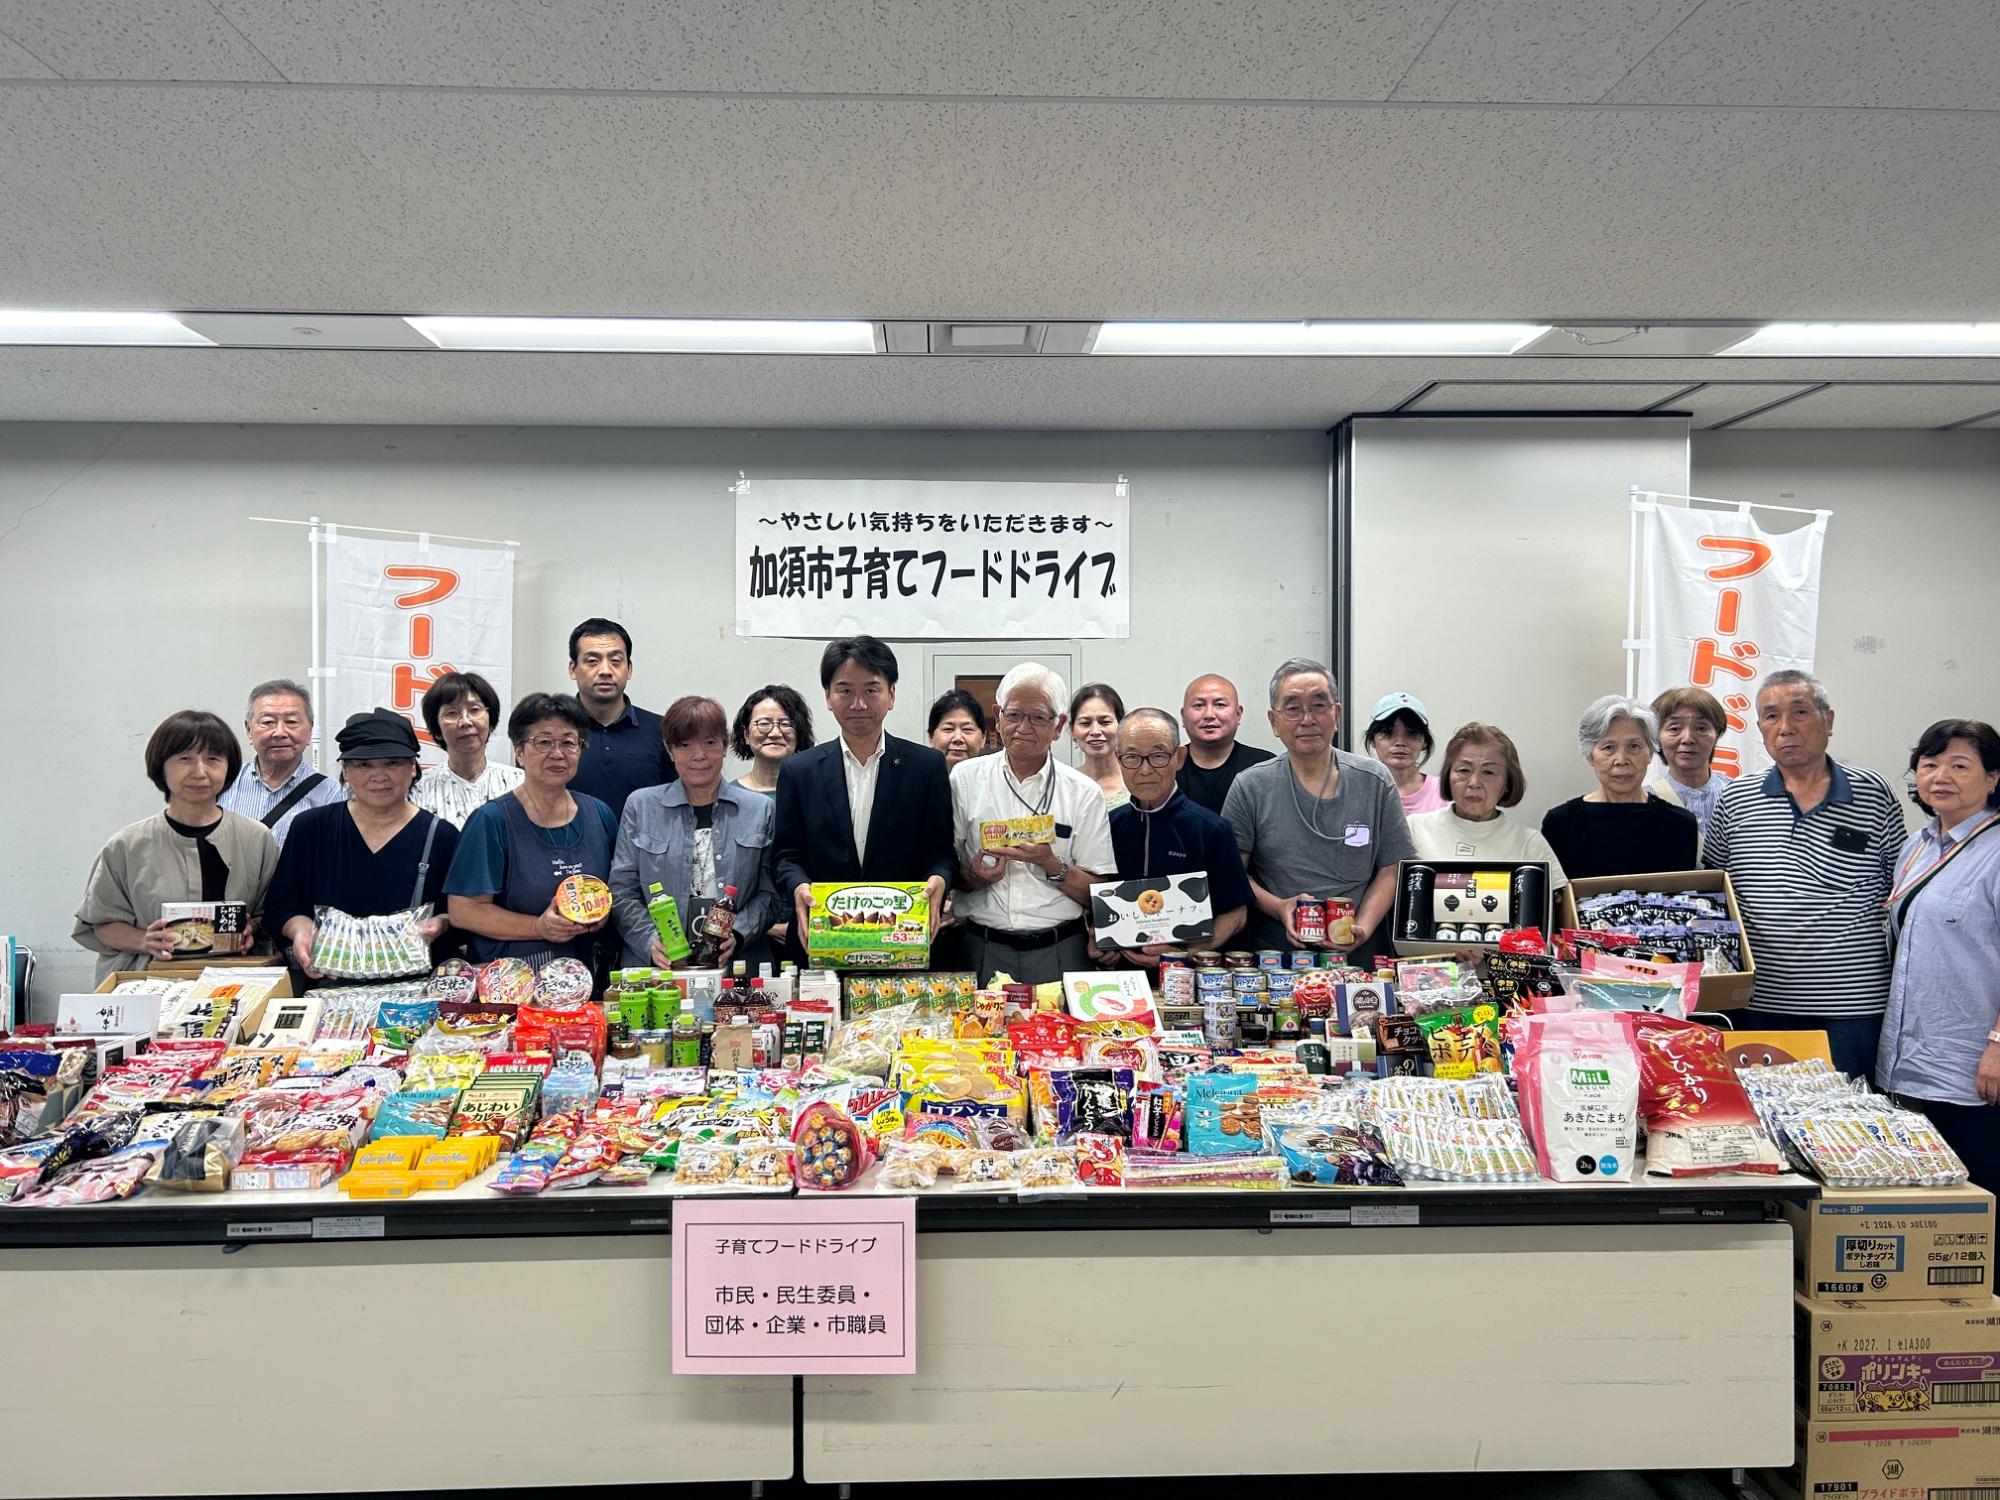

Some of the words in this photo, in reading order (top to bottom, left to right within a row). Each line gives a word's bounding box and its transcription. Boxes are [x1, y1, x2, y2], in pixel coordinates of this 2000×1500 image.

[749, 545, 1117, 599] 加須市子育てフードドライブ
[831, 895, 907, 910] たけのこの里
[1301, 927, 1324, 937] ITALY
[1572, 1071, 1608, 1084] MiiL
[1664, 1046, 1708, 1104] しひかり
[462, 1102, 519, 1112] あじわい
[927, 1104, 1004, 1117] ロアンヌ
[470, 1112, 506, 1122] カレー
[1563, 1112, 1626, 1123] あきたこまち
[715, 1238, 877, 1254] 子育てフードドライブ
[1846, 1240, 1895, 1251] 厚切りカット
[1846, 1251, 1895, 1260] ポテトチップス
[1928, 1251, 1986, 1262] 65g/12個入
[1824, 1284, 1858, 1292] 16606
[715, 1285, 871, 1305] 市民・民生委員・
[705, 1315, 887, 1334] 団体・企業・市職員
[1862, 1363, 1931, 1380] ポリンキー
[1822, 1383, 1852, 1391] 70852
[1820, 1484, 1852, 1492] 17901
[1860, 1488, 1927, 1498] プライドポテト
